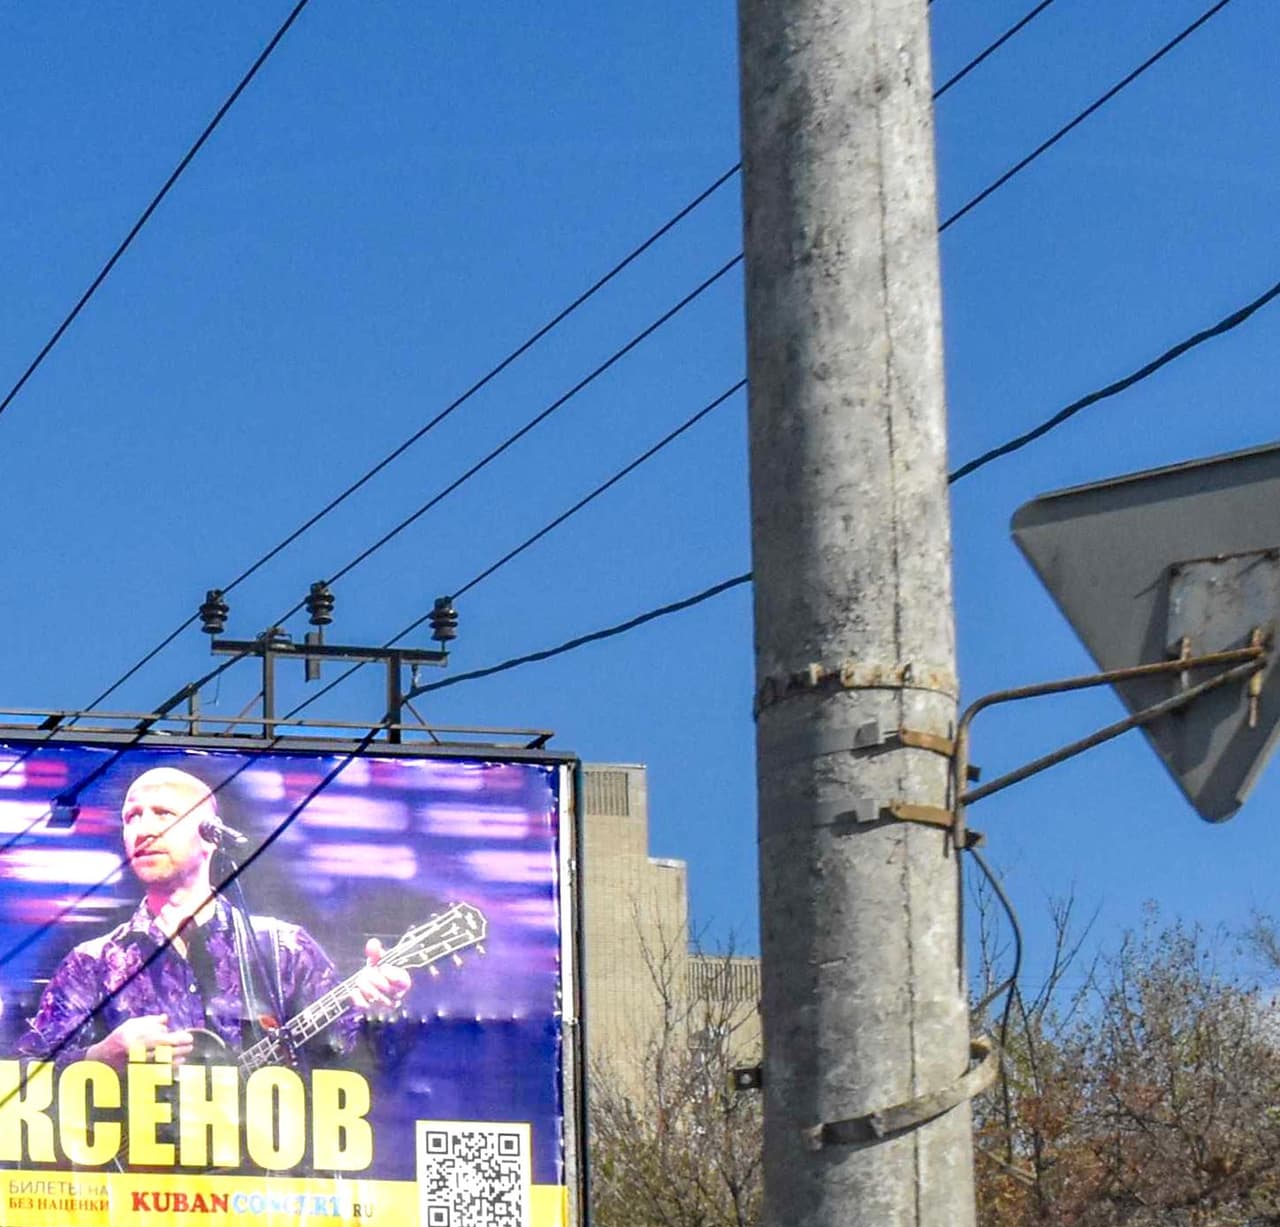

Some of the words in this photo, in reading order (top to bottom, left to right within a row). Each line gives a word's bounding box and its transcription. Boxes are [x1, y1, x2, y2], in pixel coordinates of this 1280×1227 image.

[9, 1180, 82, 1196] БИЛЕТЫ
[9, 1197, 34, 1209] БЕЗ
[38, 1198, 109, 1212] НАЦЕНКИ
